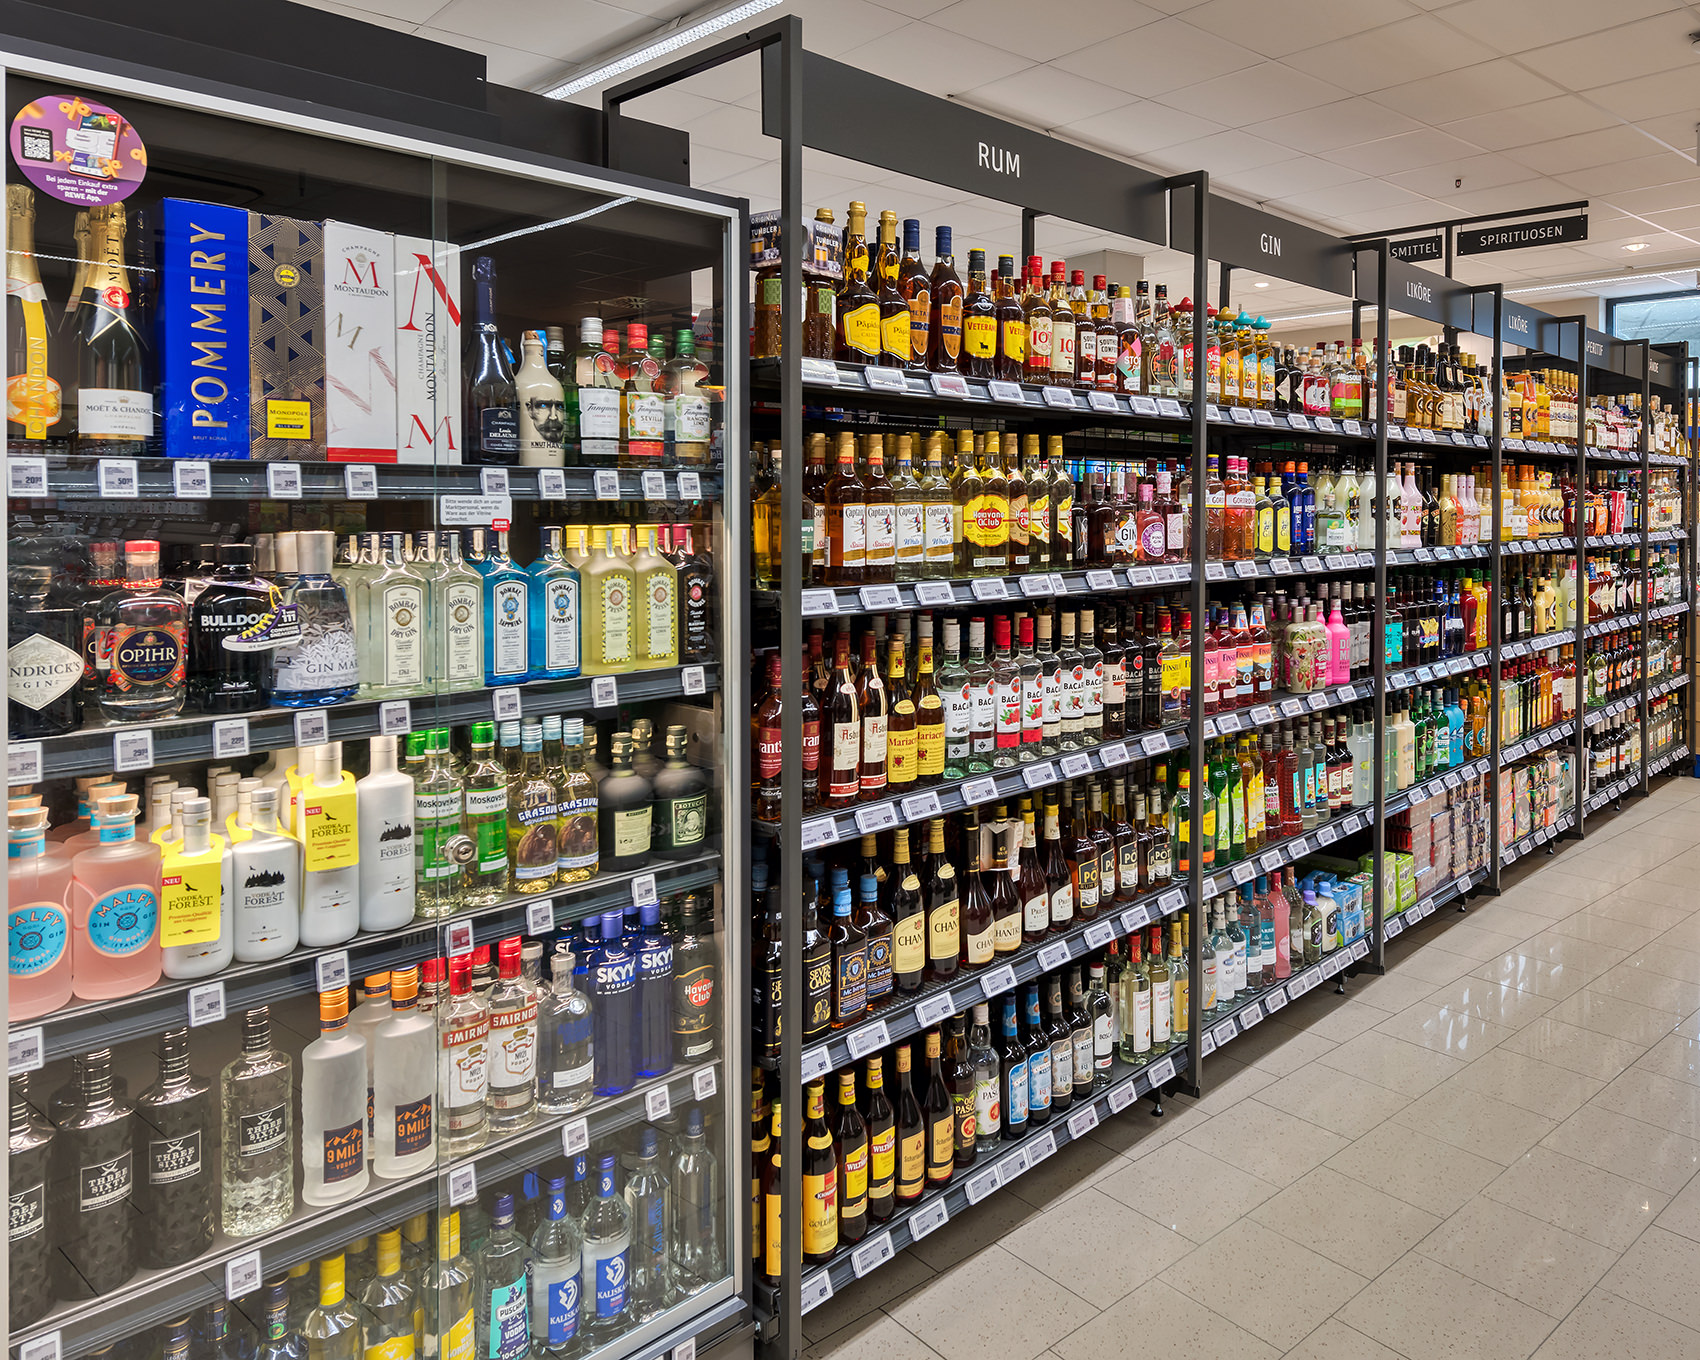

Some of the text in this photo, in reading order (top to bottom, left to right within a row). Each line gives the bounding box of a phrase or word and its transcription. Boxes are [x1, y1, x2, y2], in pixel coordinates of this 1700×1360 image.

[979, 142, 1019, 178] RUM
[46, 174, 56, 182] Bei
[57, 176, 76, 186] jedem
[78, 179, 100, 188] Einkauf
[57, 185, 79, 194] sparen
[65, 191, 101, 202] REWE App.
[751, 214, 778, 225] ORIGINAL
[751, 225, 778, 235] TUMBLER
[816, 224, 839, 237] ORIGINAL
[1480, 225, 1563, 247] SPIRITUOSEN
[816, 236, 840, 248] TUMBLER
[1260, 233, 1281, 257] GIN
[342, 245, 381, 257] CHAMPAGNE
[1390, 242, 1438, 258] SMITTEL
[104, 235, 120, 282] MOËT
[341, 257, 383, 288] M
[334, 284, 389, 297] MONTAUDON
[1406, 282, 1432, 303] LIKÖRE
[190, 222, 228, 428] POMMERY
[1508, 315, 1528, 334] LIKÖRE
[1060, 338, 1074, 353] 10
[1587, 340, 1603, 356] PERITIF
[425, 312, 436, 400] MONTAUDON
[29, 336, 45, 434] CHANDON
[86, 404, 109, 412] MOËT
[404, 414, 459, 450] M
[845, 507, 864, 517] Captain
[868, 506, 887, 518] Captain
[898, 506, 918, 517] Captain
[927, 506, 944, 517] Captain
[500, 587, 522, 597] BOMBAY
[551, 584, 572, 593] BOMBAY
[389, 602, 419, 613] BOMBAY
[449, 598, 475, 608] BOMBAY
[498, 619, 523, 628] SAPPHIRE
[550, 615, 574, 624] SAPPHIRE
[390, 628, 418, 638] DRY GIN
[449, 624, 475, 635] DRY GIN
[120, 646, 177, 663] OPIHR
[306, 663, 332, 674] GIN
[23, 679, 53, 689] GIN
[311, 824, 351, 838] FOREST
[318, 823, 341, 831] VODKA
[380, 845, 412, 858] FOREST
[164, 877, 181, 886] NEU
[1084, 870, 1098, 882] PO
[168, 896, 214, 910] FOREST
[176, 894, 203, 903] VODKA
[244, 891, 285, 906] FOREST
[96, 893, 154, 918] MALFY
[8, 911, 62, 930] ALFY
[49, 930, 64, 939] GIN
[641, 944, 673, 969] SKYY
[597, 955, 636, 983] SKYY
[651, 965, 671, 975] VODKA
[606, 981, 630, 990] VODKA
[692, 991, 710, 1003] Club
[511, 1057, 529, 1066] VODKA
[247, 1118, 282, 1135] THREE
[398, 1113, 431, 1137] 9 MILE
[249, 1126, 281, 1142] SIXTY
[407, 1133, 425, 1144] VODKA
[156, 1147, 195, 1162] THREE
[327, 1140, 362, 1164] 9 MILE
[158, 1154, 193, 1169] SIXTY
[336, 1159, 356, 1170] VODKA
[88, 1166, 128, 1188] THREE
[91, 1175, 127, 1195] SIXTY
[11, 1200, 38, 1216] REE
[504, 1323, 525, 1338] VODKA
